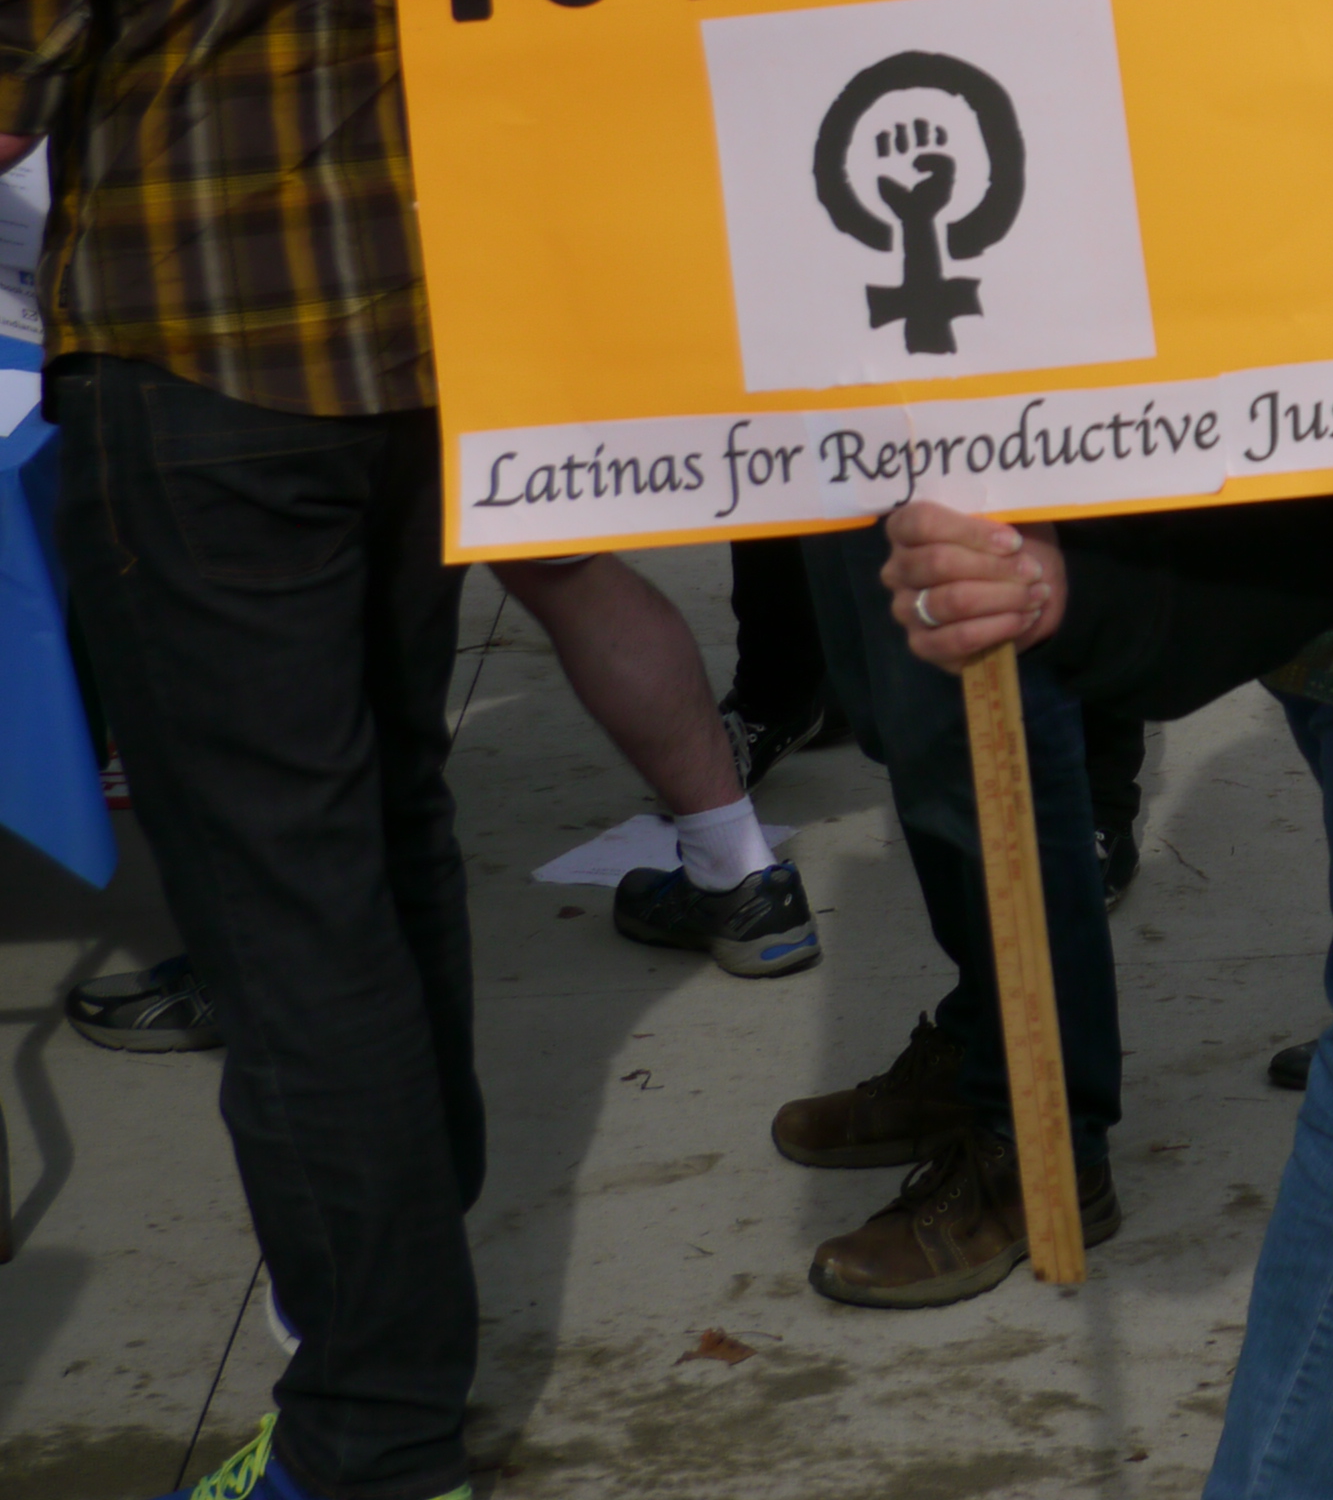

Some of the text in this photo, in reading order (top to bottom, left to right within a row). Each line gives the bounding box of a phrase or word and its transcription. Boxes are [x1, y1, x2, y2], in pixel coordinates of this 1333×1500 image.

[472, 442, 705, 508] Latinas
[714, 420, 804, 518] for
[819, 399, 1221, 508] Reproductive
